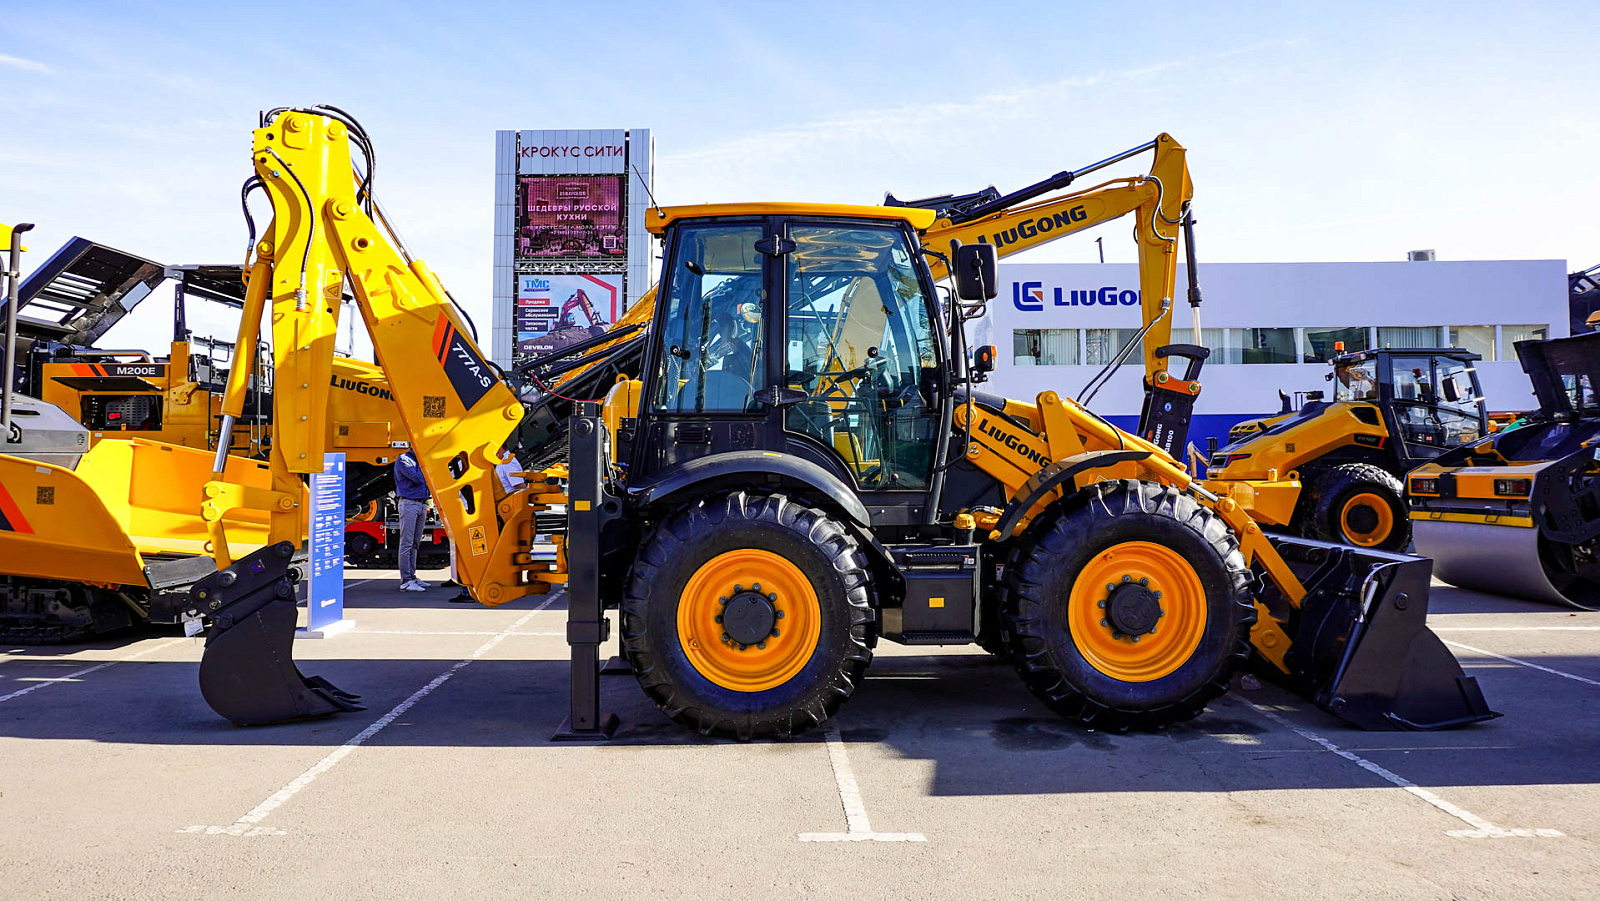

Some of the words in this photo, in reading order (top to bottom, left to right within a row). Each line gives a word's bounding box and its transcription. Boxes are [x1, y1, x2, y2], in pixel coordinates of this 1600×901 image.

[521, 146, 580, 157] КРОКУС
[584, 146, 623, 157] СИТИ
[1054, 287, 1141, 306] LIUGO
[116, 366, 156, 375] M200E
[452, 342, 492, 388] 777A-S
[1153, 423, 1163, 446] GONG
